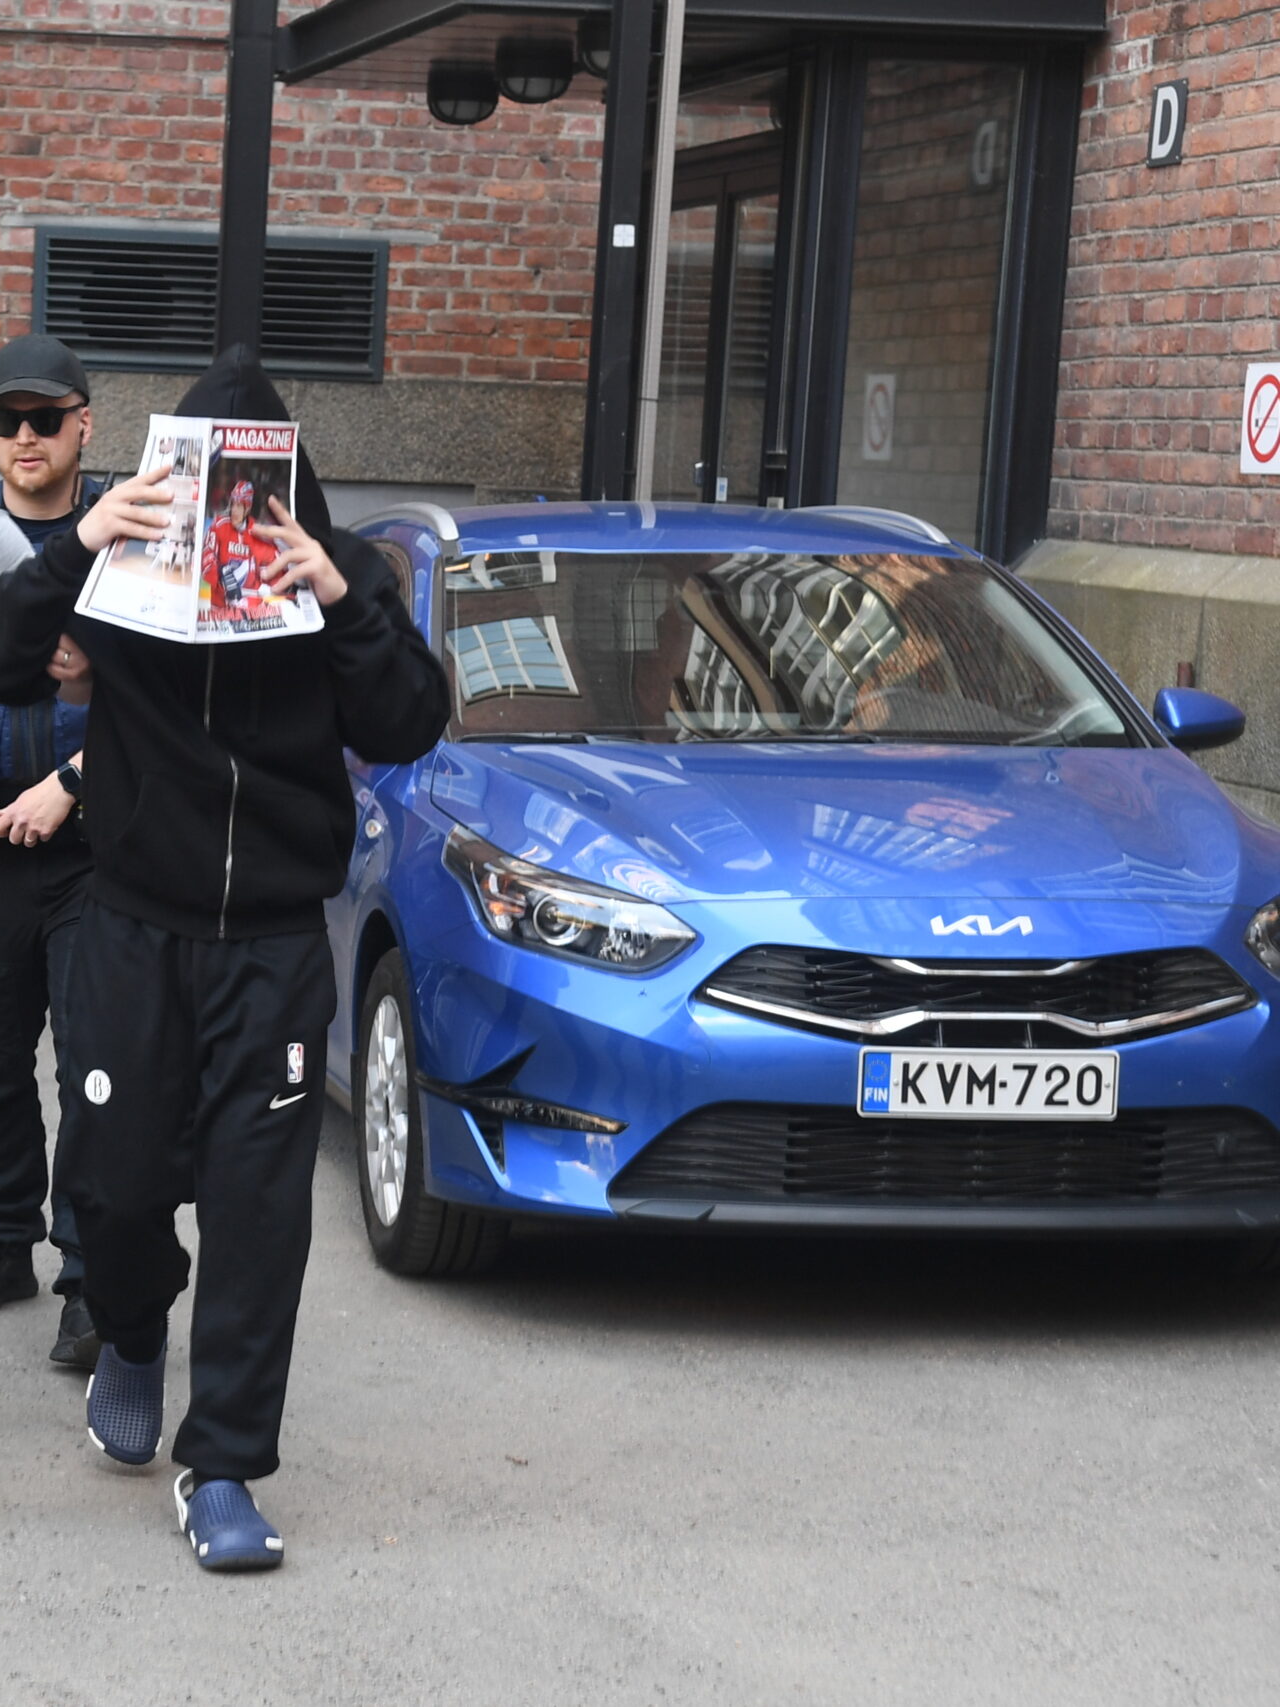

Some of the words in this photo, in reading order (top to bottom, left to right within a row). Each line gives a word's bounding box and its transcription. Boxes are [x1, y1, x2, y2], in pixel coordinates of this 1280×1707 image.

[1151, 86, 1179, 159] D
[225, 428, 293, 451] MAGAZINE
[864, 1087, 888, 1103] FIN
[901, 1061, 1103, 1107] KVM-720
